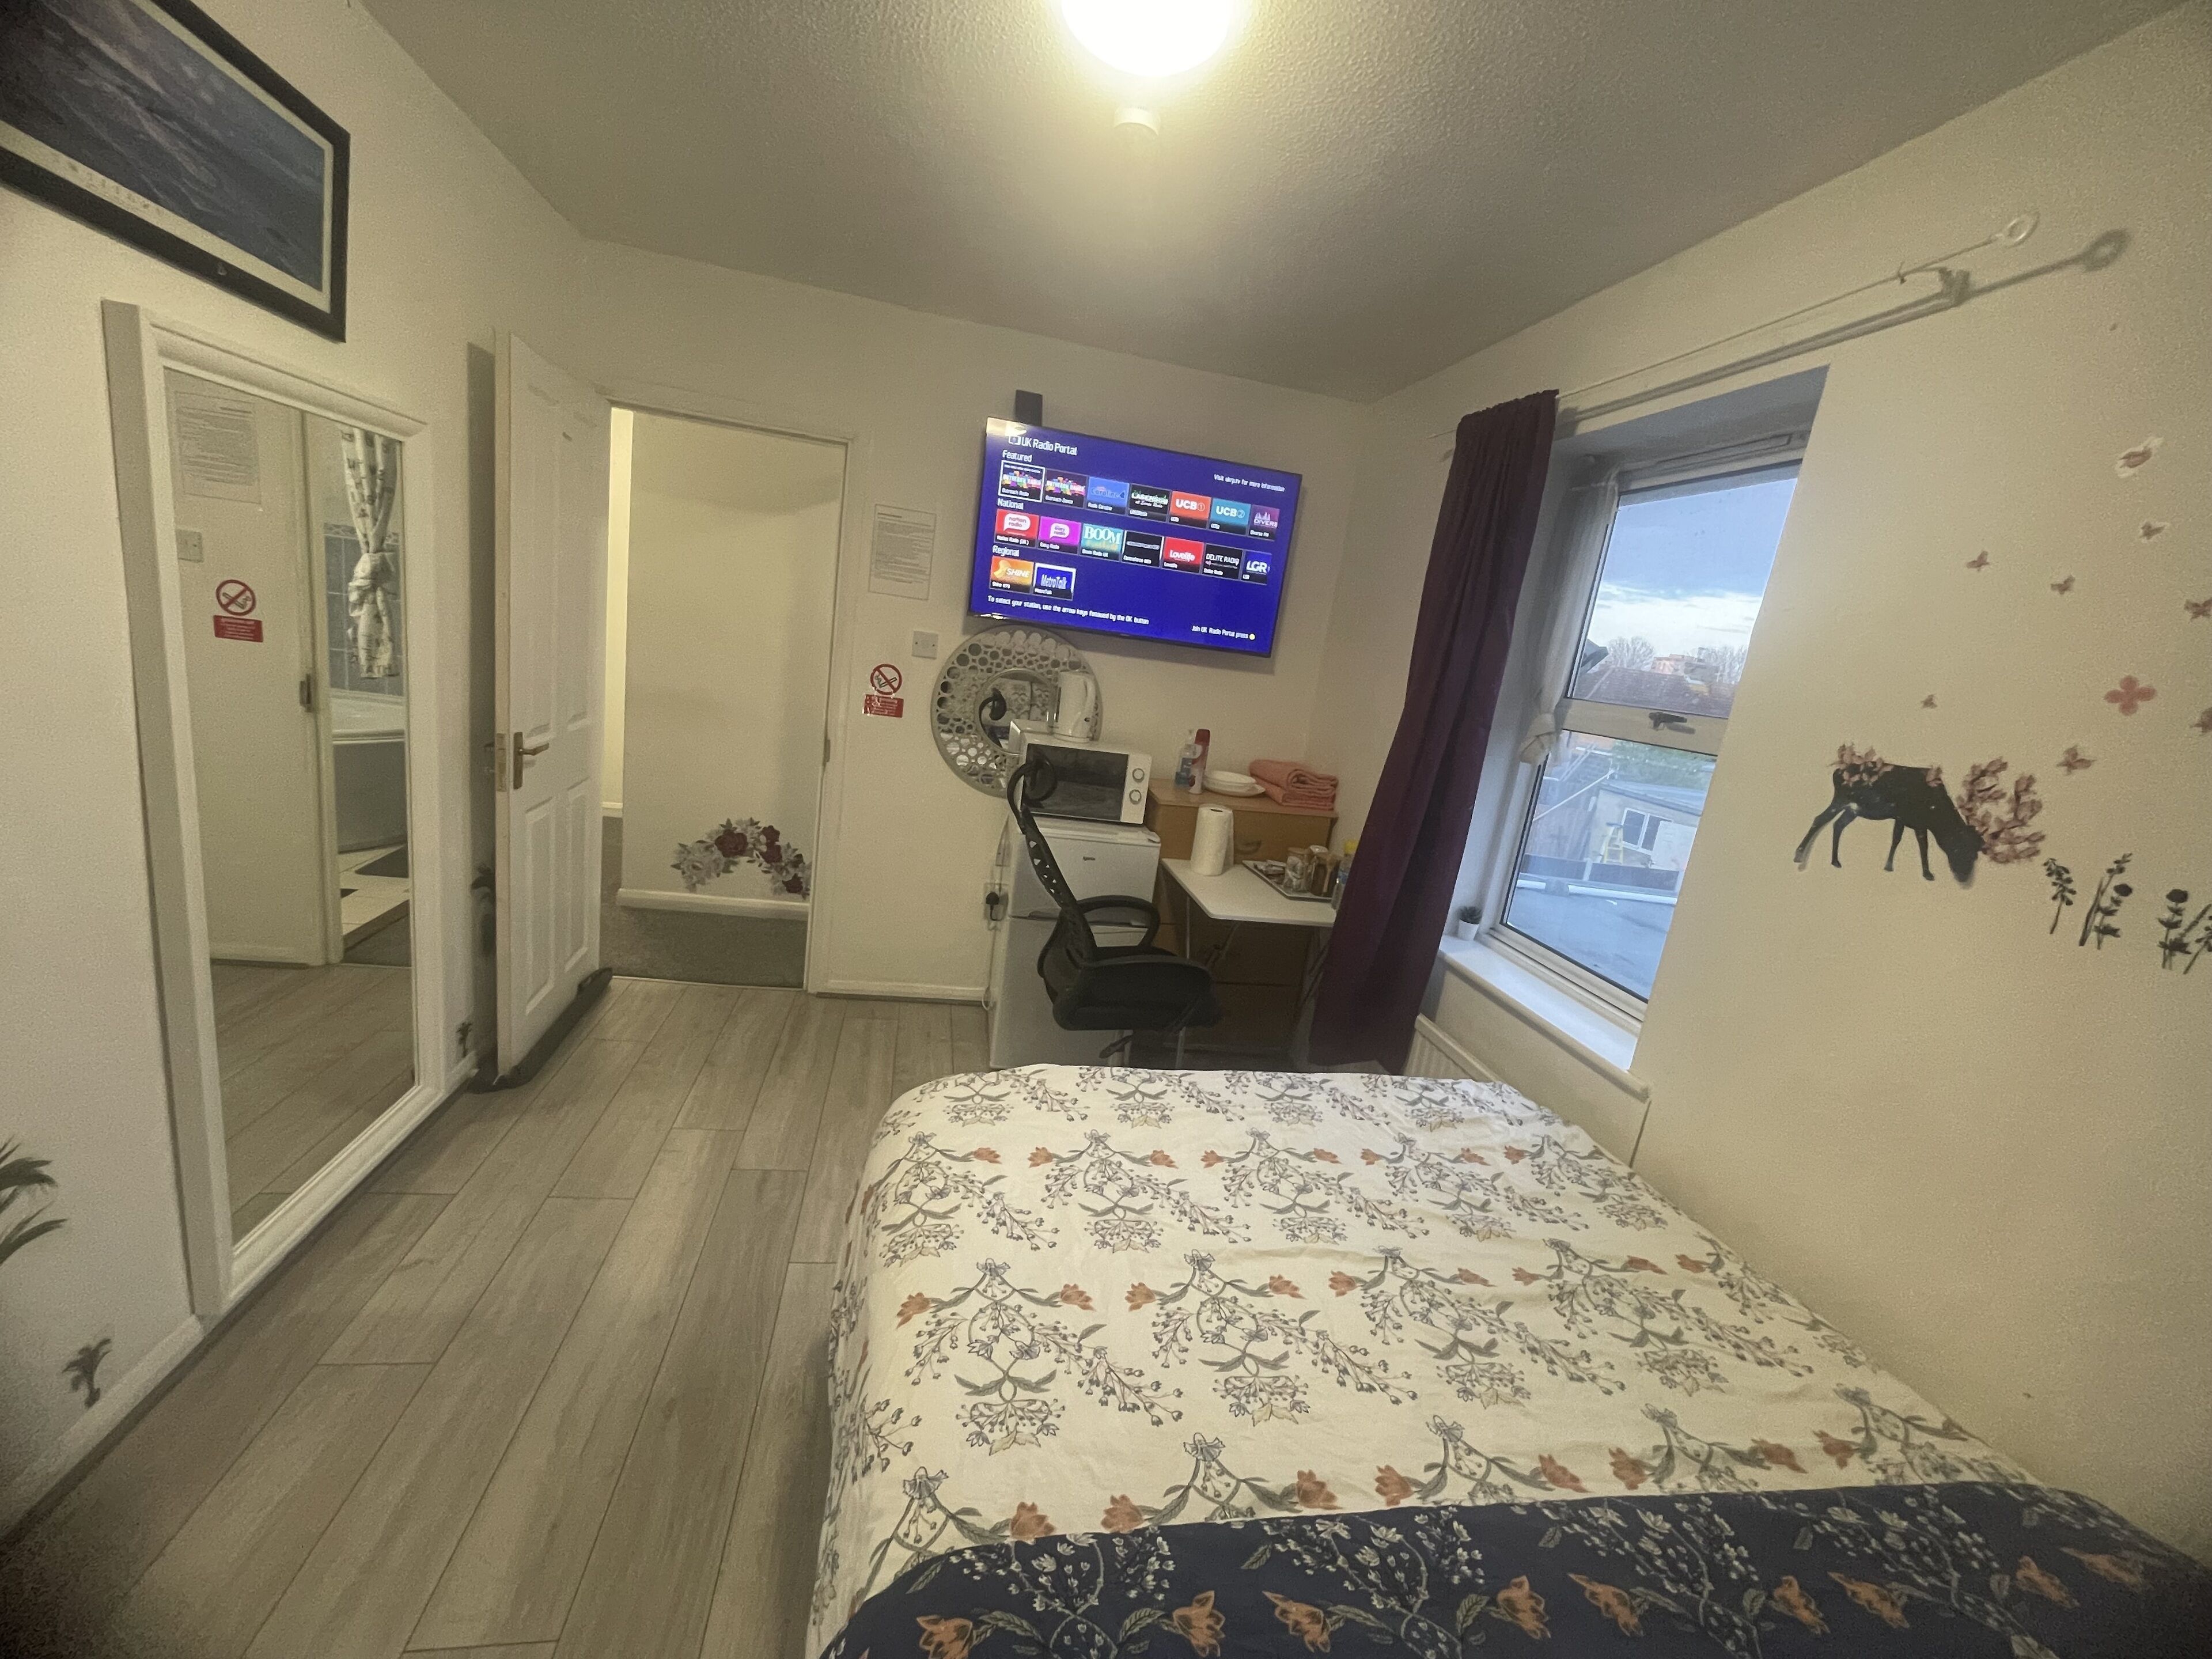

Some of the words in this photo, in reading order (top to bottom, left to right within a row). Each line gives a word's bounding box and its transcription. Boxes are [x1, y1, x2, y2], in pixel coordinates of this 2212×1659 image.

[1022, 437, 1032, 447] UK
[1033, 439, 1053, 451] Radio
[1054, 442, 1077, 456] Portal
[1002, 450, 1032, 462] Featured
[1214, 474, 1224, 482] Visit
[1261, 483, 1285, 492] information
[997, 498, 1024, 510] National
[1084, 526, 1121, 544] BOOM
[992, 545, 1020, 557] Regional
[1206, 553, 1224, 562] DELITE
[1246, 560, 1267, 573] LGR
[1006, 568, 1031, 578] SHINE
[1041, 574, 1067, 589] MetroTalk
[1109, 613, 1116, 622] by
[1222, 629, 1235, 637] Portal
